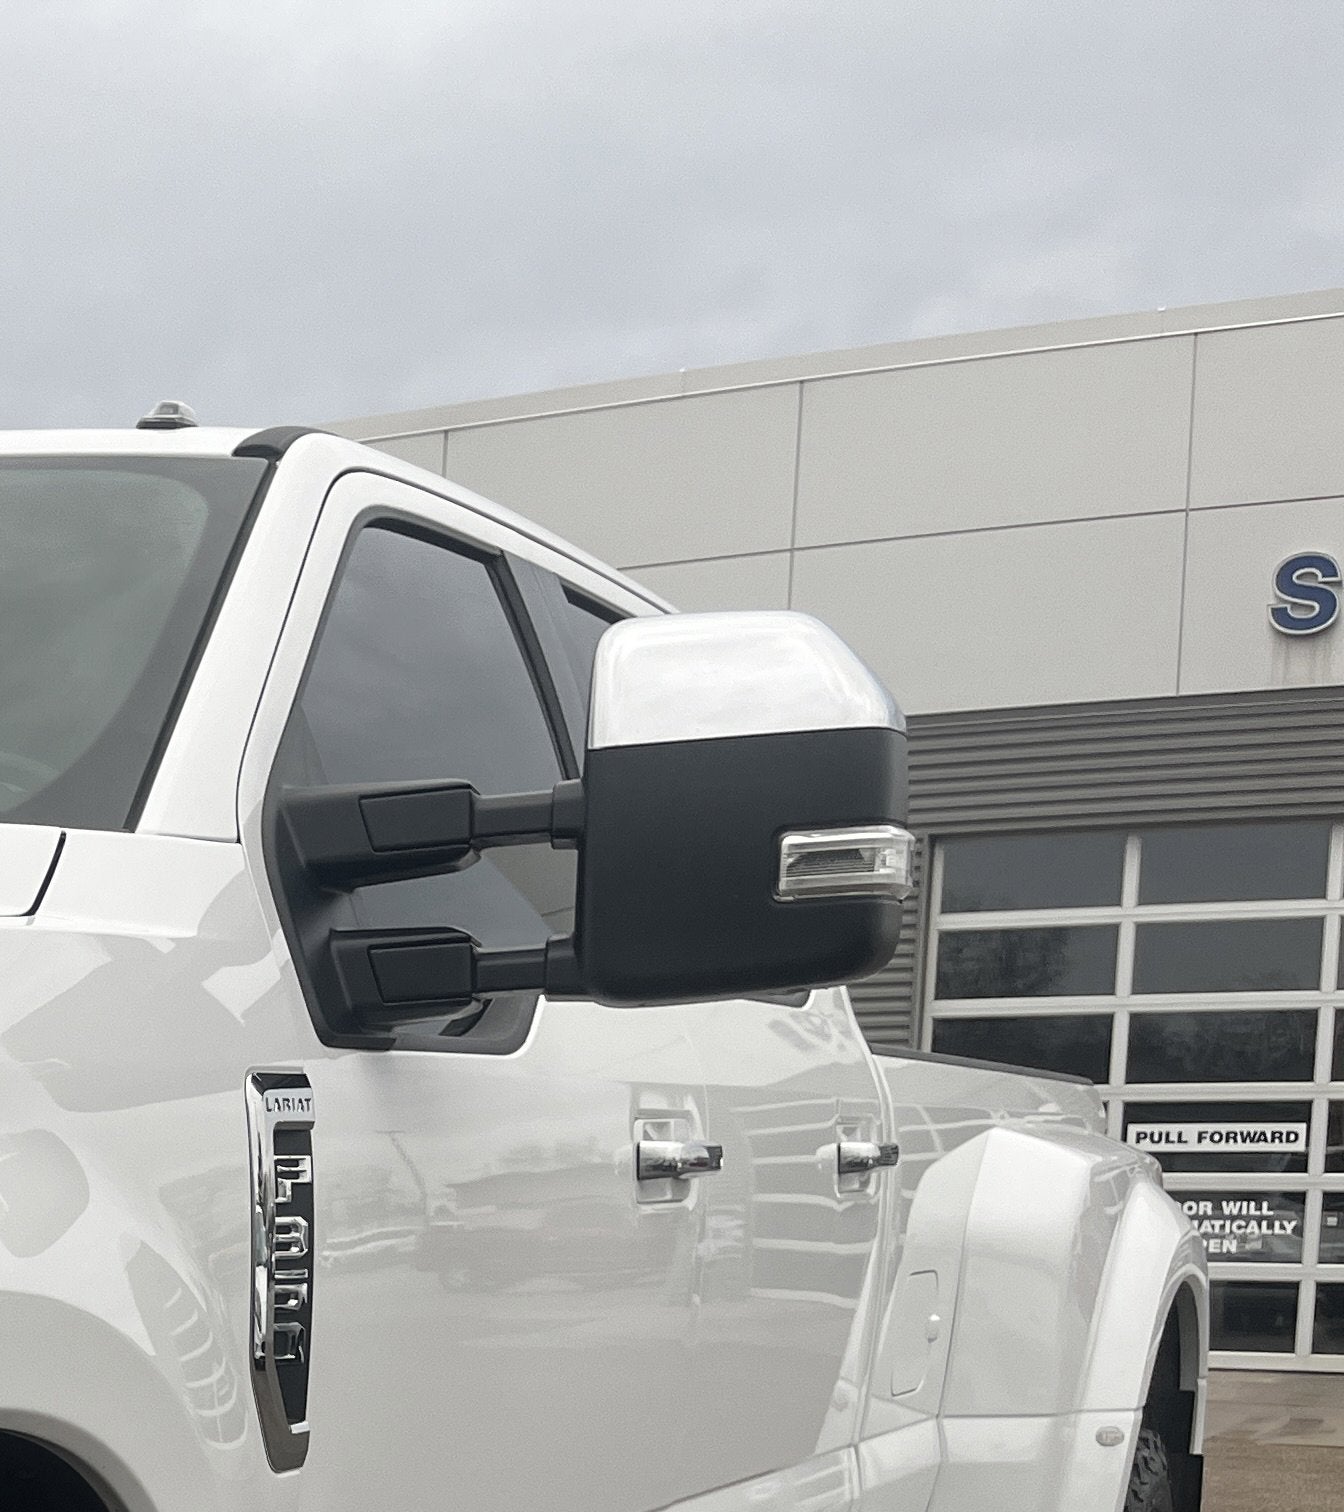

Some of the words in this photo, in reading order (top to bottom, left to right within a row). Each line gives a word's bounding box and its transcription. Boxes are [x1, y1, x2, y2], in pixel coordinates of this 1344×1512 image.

[265, 1097, 311, 1112] LARIAT
[1135, 1131, 1188, 1144] PULL
[1197, 1131, 1299, 1144] FORWARD
[1178, 1200, 1213, 1216] OR
[1221, 1200, 1275, 1216] WILL
[1192, 1219, 1297, 1235] ATICALLY
[1203, 1238, 1237, 1254] EN
